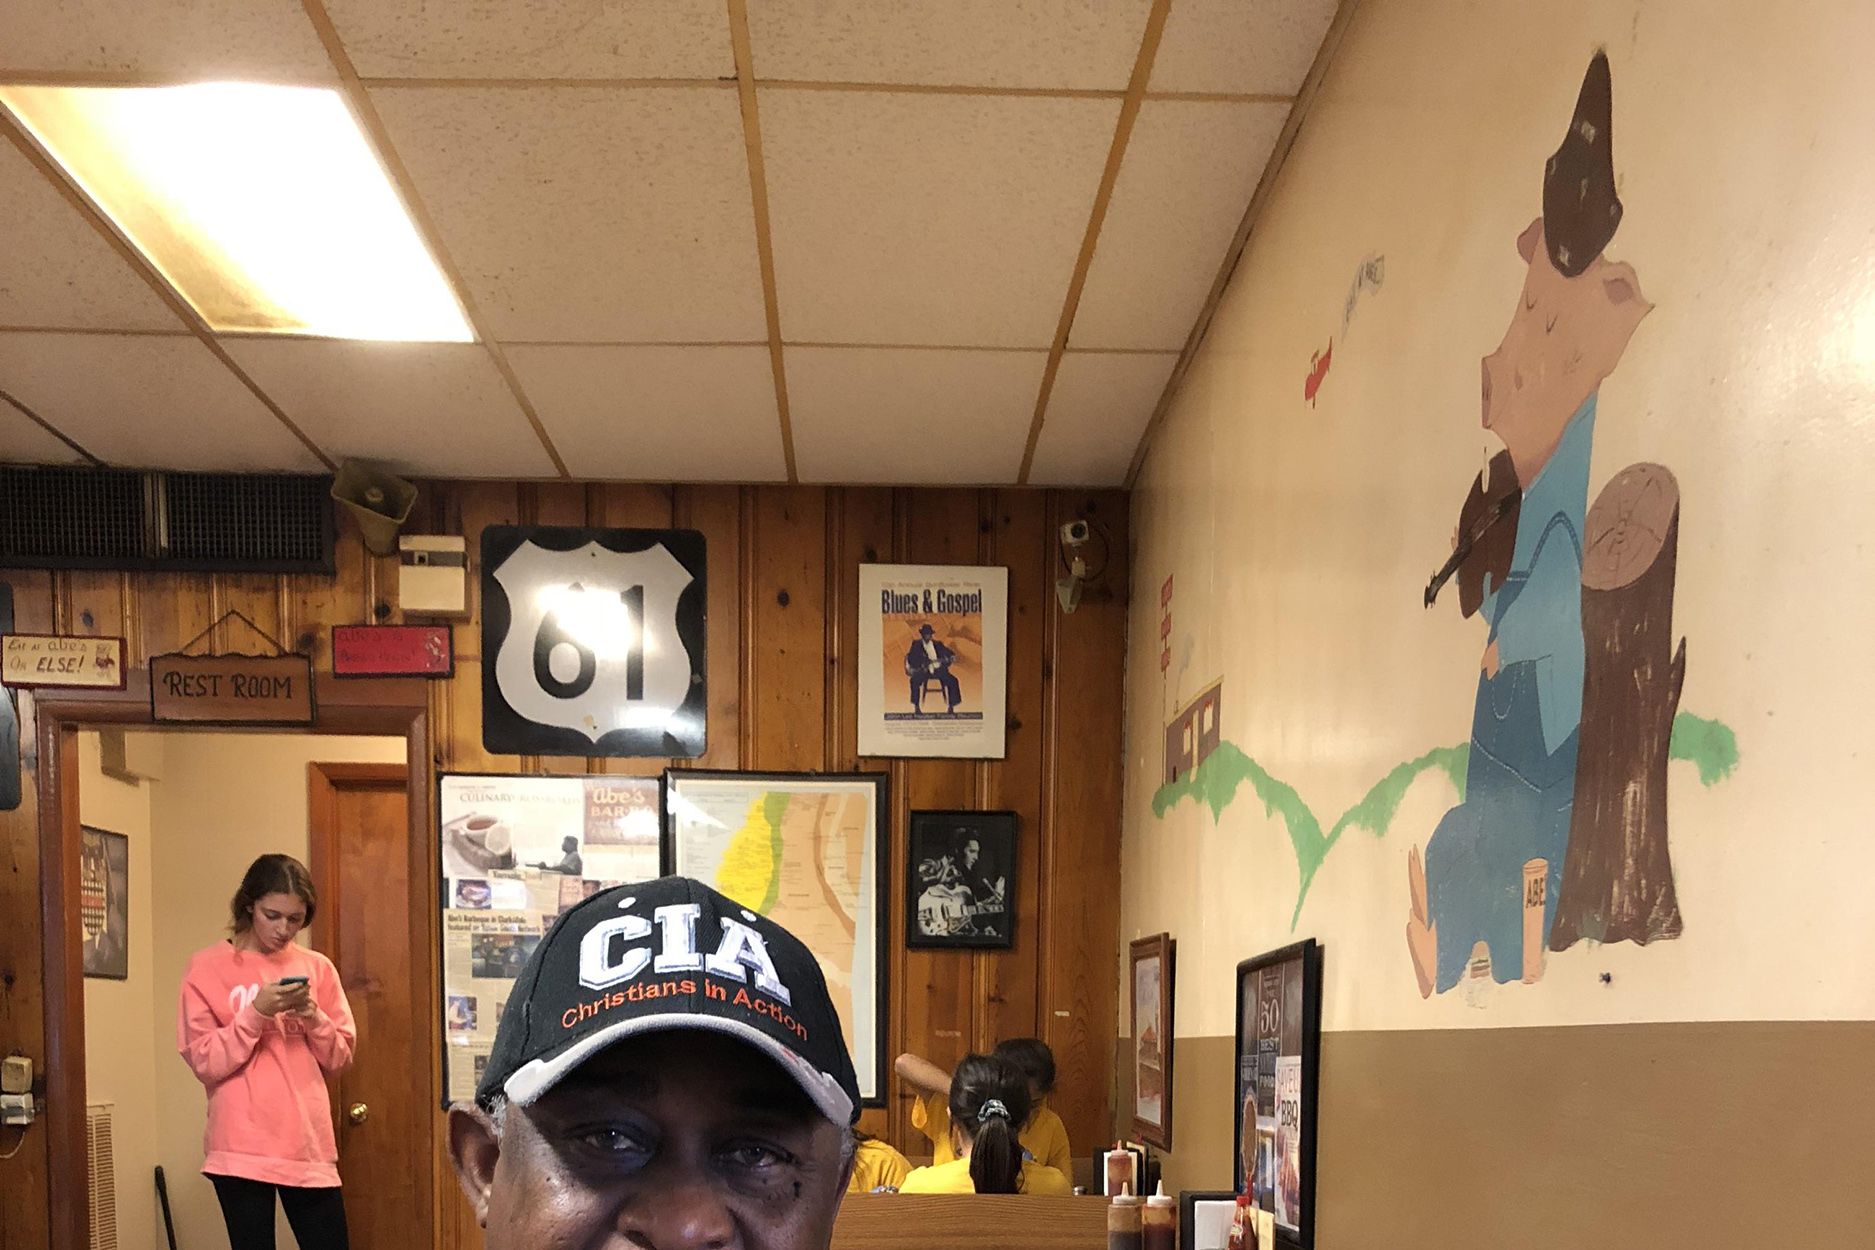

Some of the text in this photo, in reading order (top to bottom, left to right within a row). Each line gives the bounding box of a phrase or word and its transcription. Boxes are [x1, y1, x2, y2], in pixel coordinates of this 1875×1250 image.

[881, 588, 982, 617] Blues & Gospel
[533, 581, 644, 700] 61
[36, 654, 85, 673] ELSE!
[162, 671, 293, 699] REST ROOM
[460, 792, 512, 802] CULINARY
[578, 902, 792, 1007] CIA
[561, 978, 808, 1042] Christians in Action
[1261, 998, 1280, 1033] 50
[1260, 1037, 1279, 1051] BEST
[1281, 1099, 1299, 1132] BBQ
